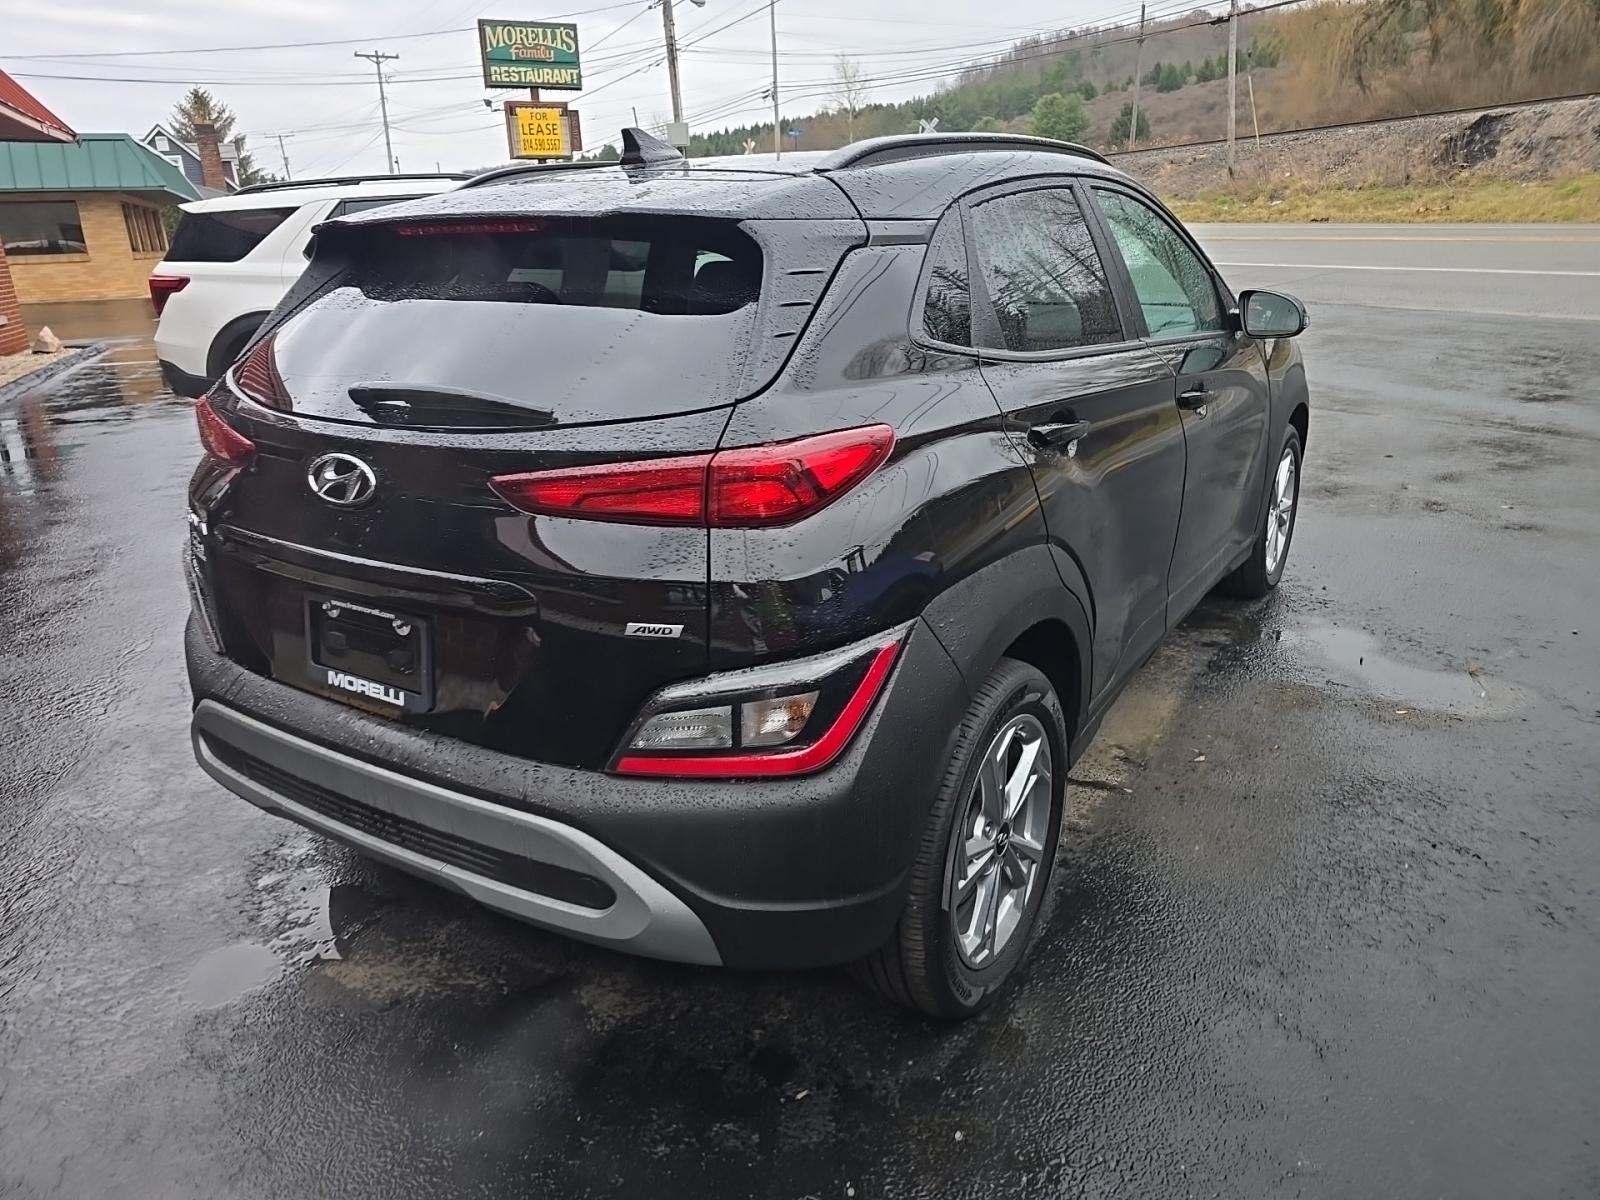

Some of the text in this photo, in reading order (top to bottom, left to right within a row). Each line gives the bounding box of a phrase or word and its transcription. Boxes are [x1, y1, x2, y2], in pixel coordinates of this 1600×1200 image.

[509, 44, 554, 62] Family
[490, 65, 579, 84] RESTAURANT
[530, 112, 548, 121] FOR
[521, 123, 558, 136] LEASE
[632, 626, 673, 635] AWD
[327, 670, 405, 706] MORELLI
